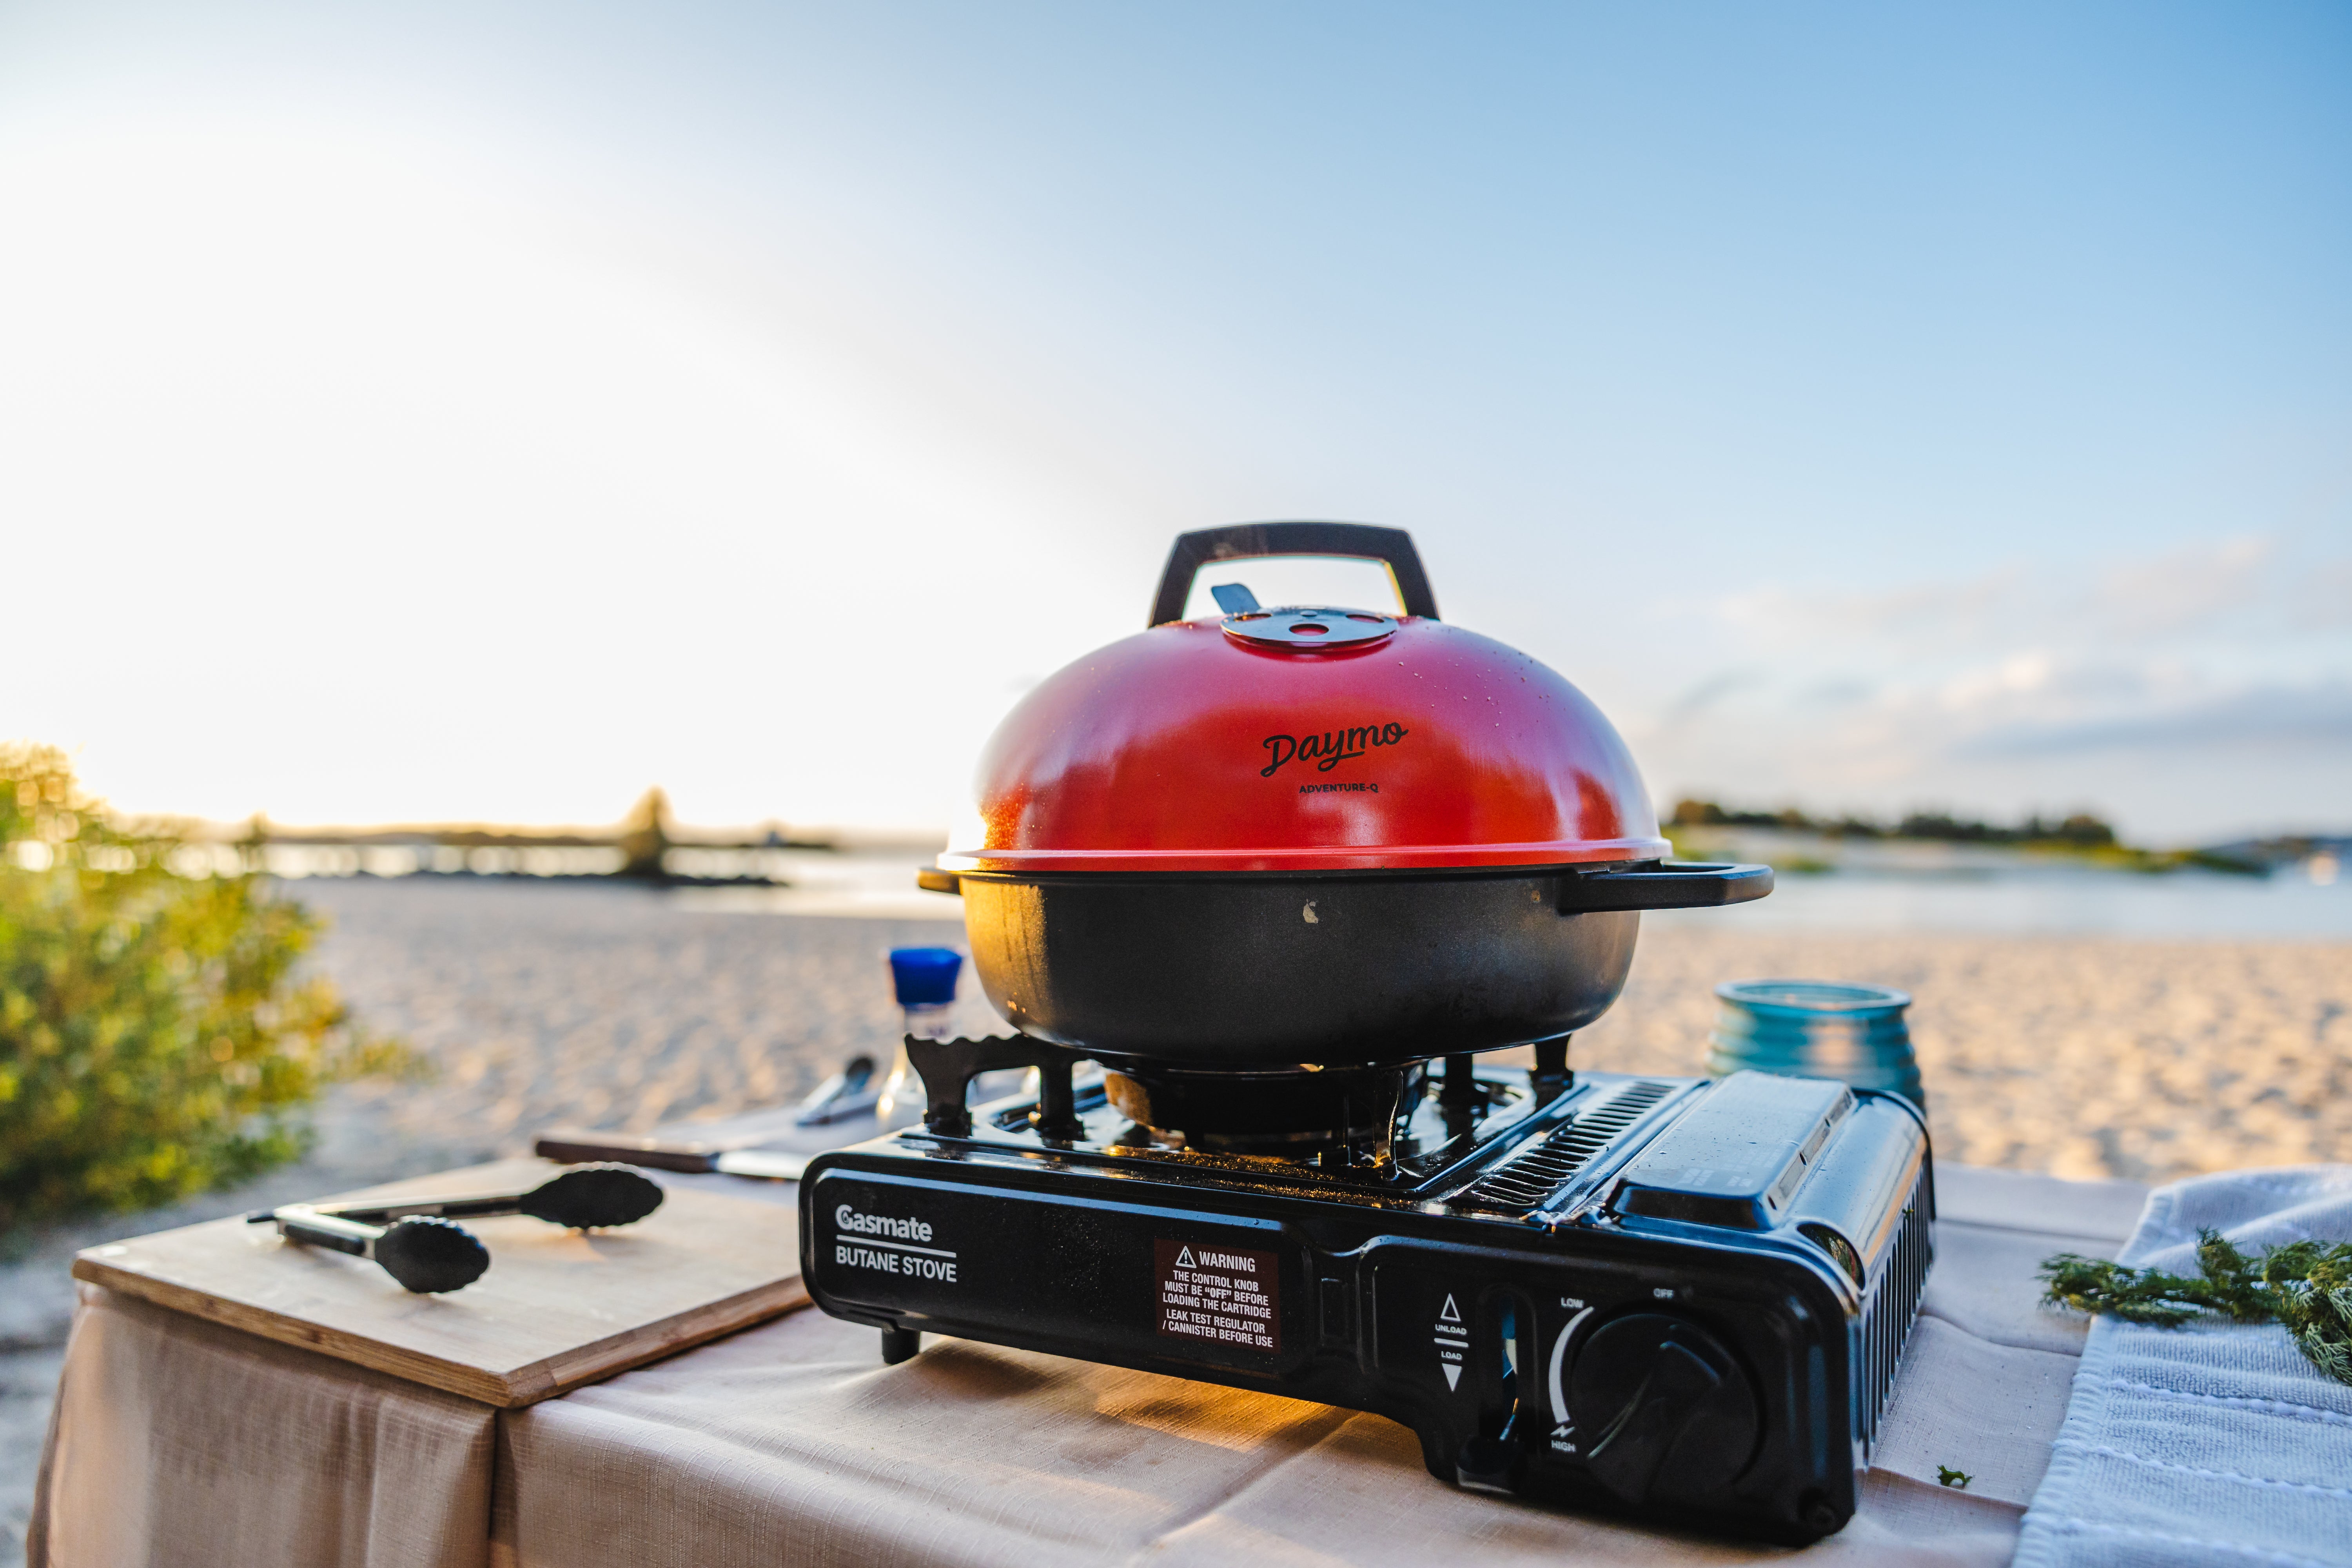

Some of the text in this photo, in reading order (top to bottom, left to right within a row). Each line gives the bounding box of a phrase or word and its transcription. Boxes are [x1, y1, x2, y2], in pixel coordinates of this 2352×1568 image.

[1260, 722, 1409, 777] Daymo
[1299, 783, 1379, 793] ADVENTURE-Q
[835, 1204, 933, 1242] Gasmate
[835, 1245, 957, 1282] BUTANE STOVE
[1199, 1251, 1255, 1272] WARNING
[1173, 1270, 1259, 1292] THE CONTROL KNOB
[1165, 1281, 1189, 1293] MUST
[1191, 1285, 1203, 1296] BE
[1234, 1291, 1269, 1306] BEFORE
[1561, 1296, 1584, 1308] LOW
[1163, 1292, 1271, 1319] LOADING THE CARTRIDGE
[1167, 1308, 1265, 1334] LEAK TEST REGULATOR
[1435, 1324, 1467, 1336] UNLOAD
[1169, 1321, 1216, 1338] CANNISTER
[1219, 1329, 1253, 1344] BEFORE
[1255, 1335, 1273, 1347] USE
[1441, 1351, 1463, 1361] LOAD
[1551, 1440, 1576, 1452] HIGH
